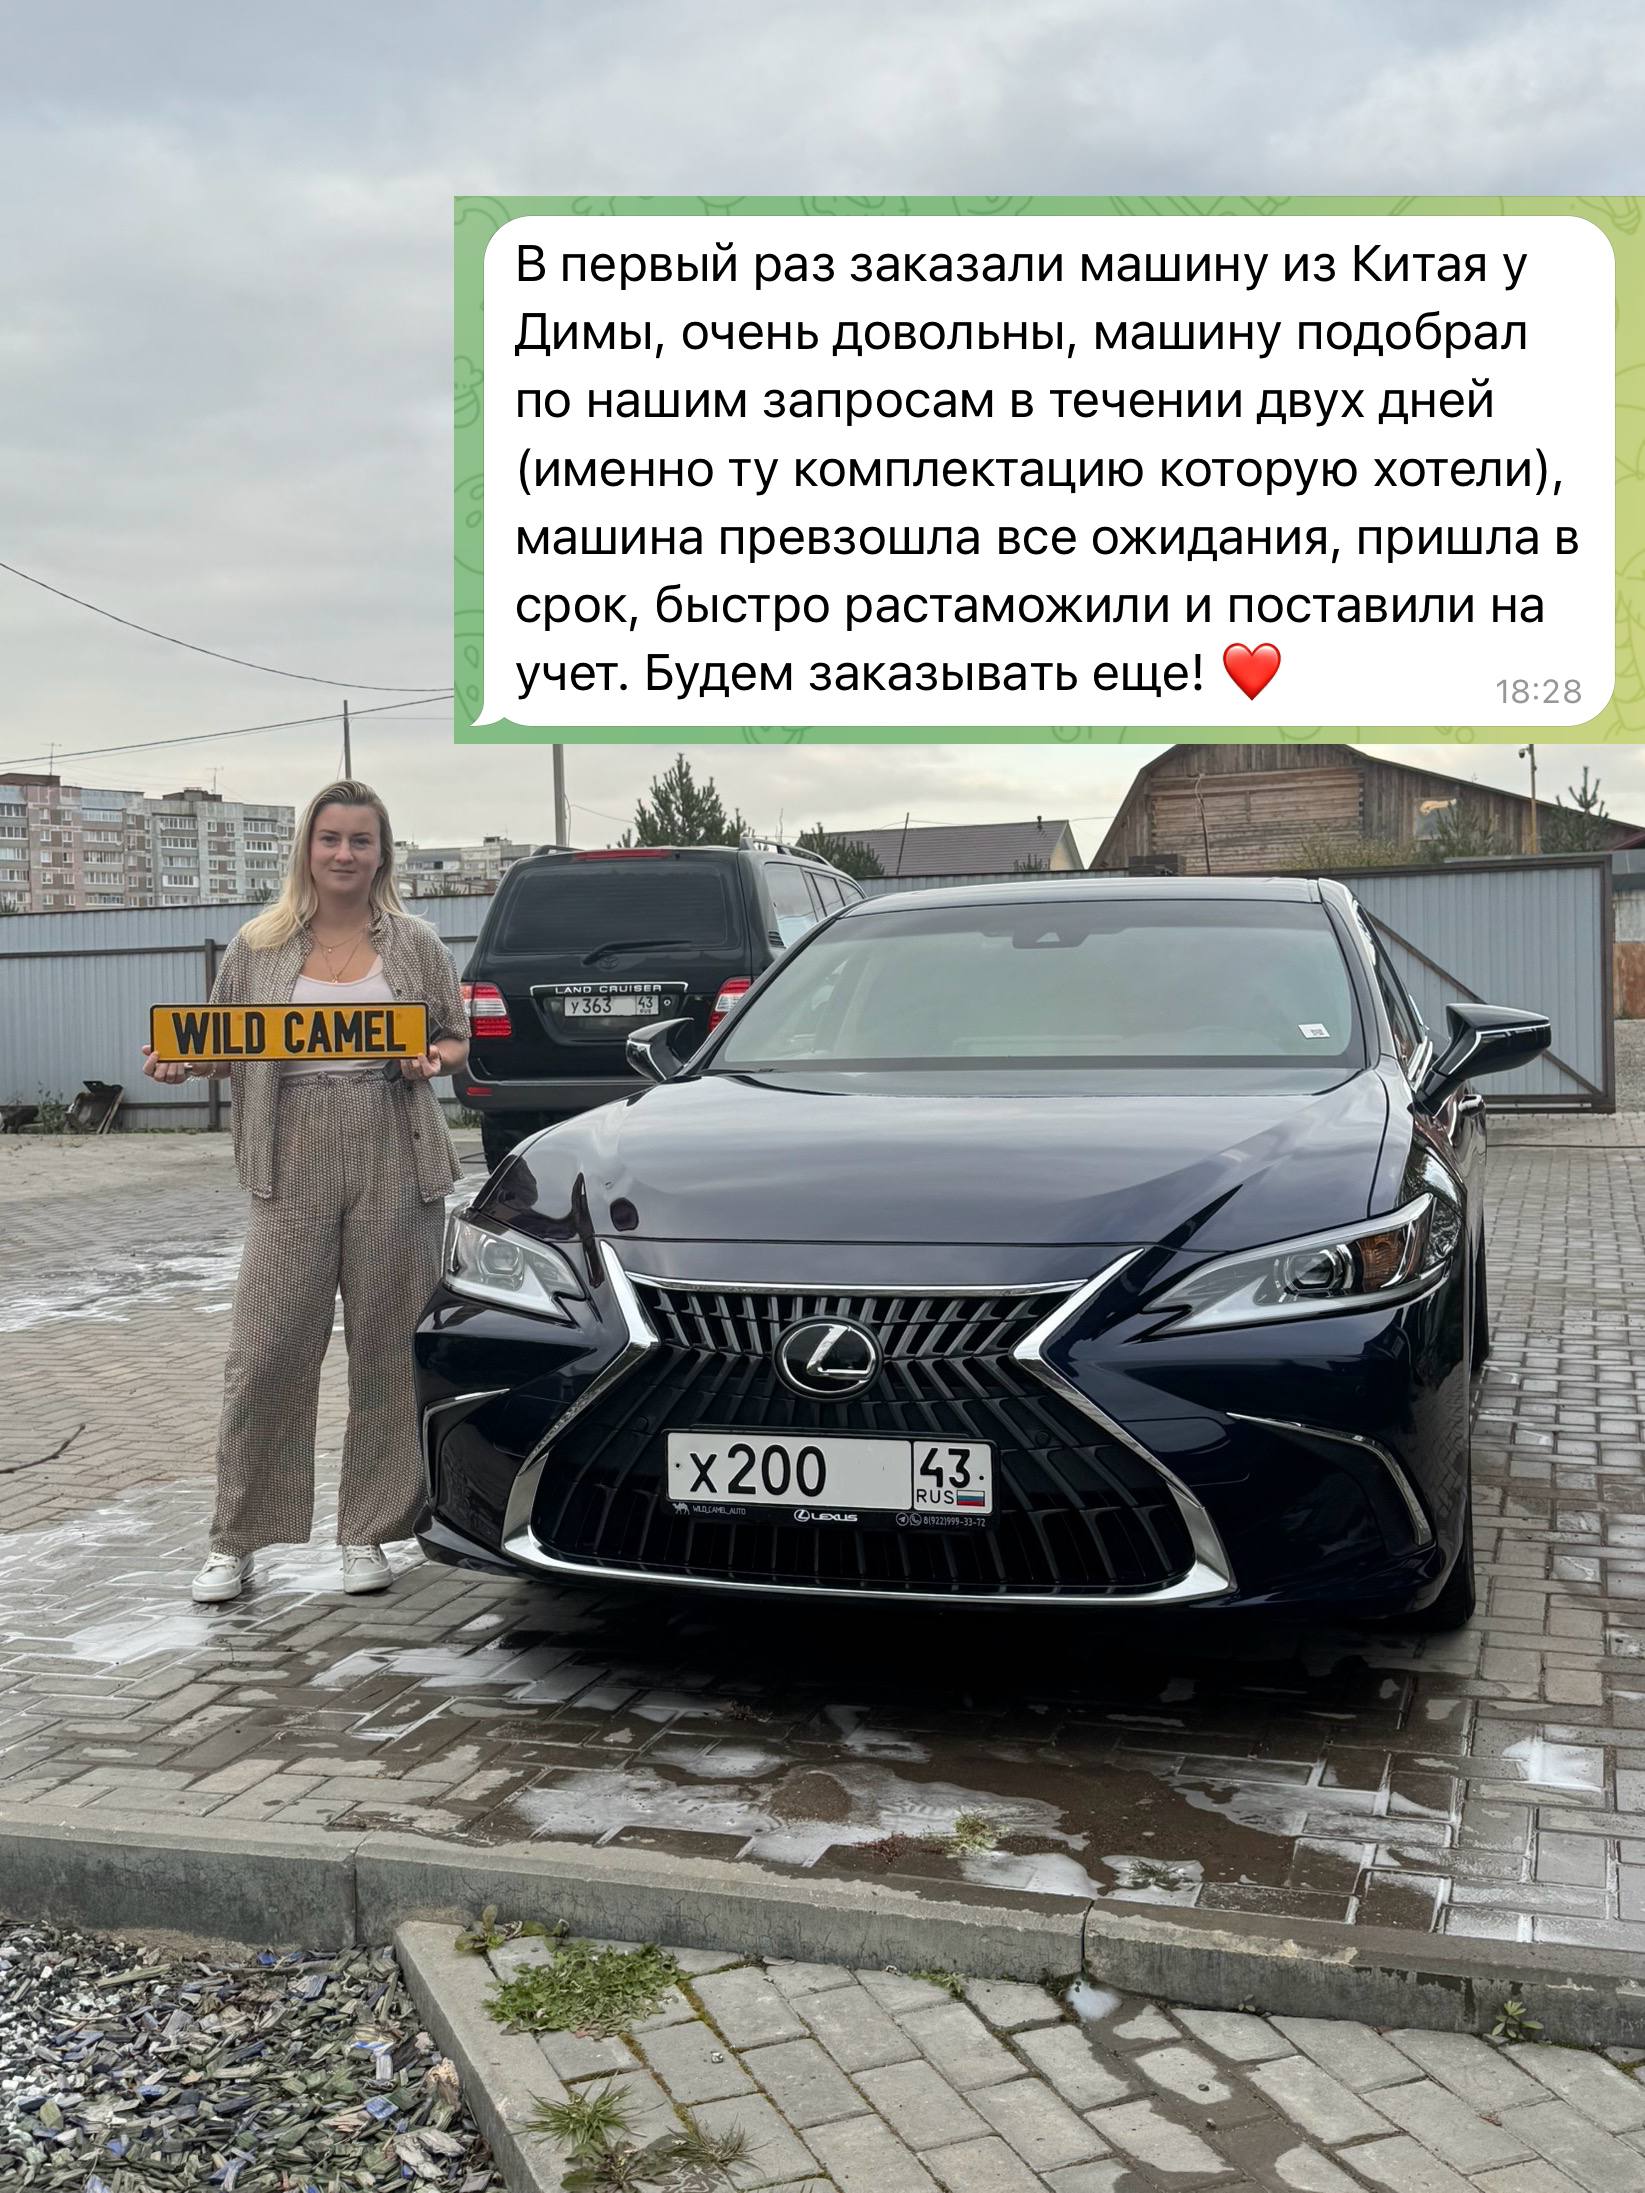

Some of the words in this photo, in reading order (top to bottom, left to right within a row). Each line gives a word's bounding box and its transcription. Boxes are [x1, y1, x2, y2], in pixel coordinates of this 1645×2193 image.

[555, 986, 592, 994] LAND
[599, 984, 662, 994] CRUISER
[638, 996, 653, 1009] 43
[172, 1011, 266, 1055] WILD
[284, 1010, 406, 1054] CAMEL
[920, 1447, 971, 1489] 43
[917, 1489, 954, 1504] RUS
[811, 1513, 858, 1522] LEXUS
